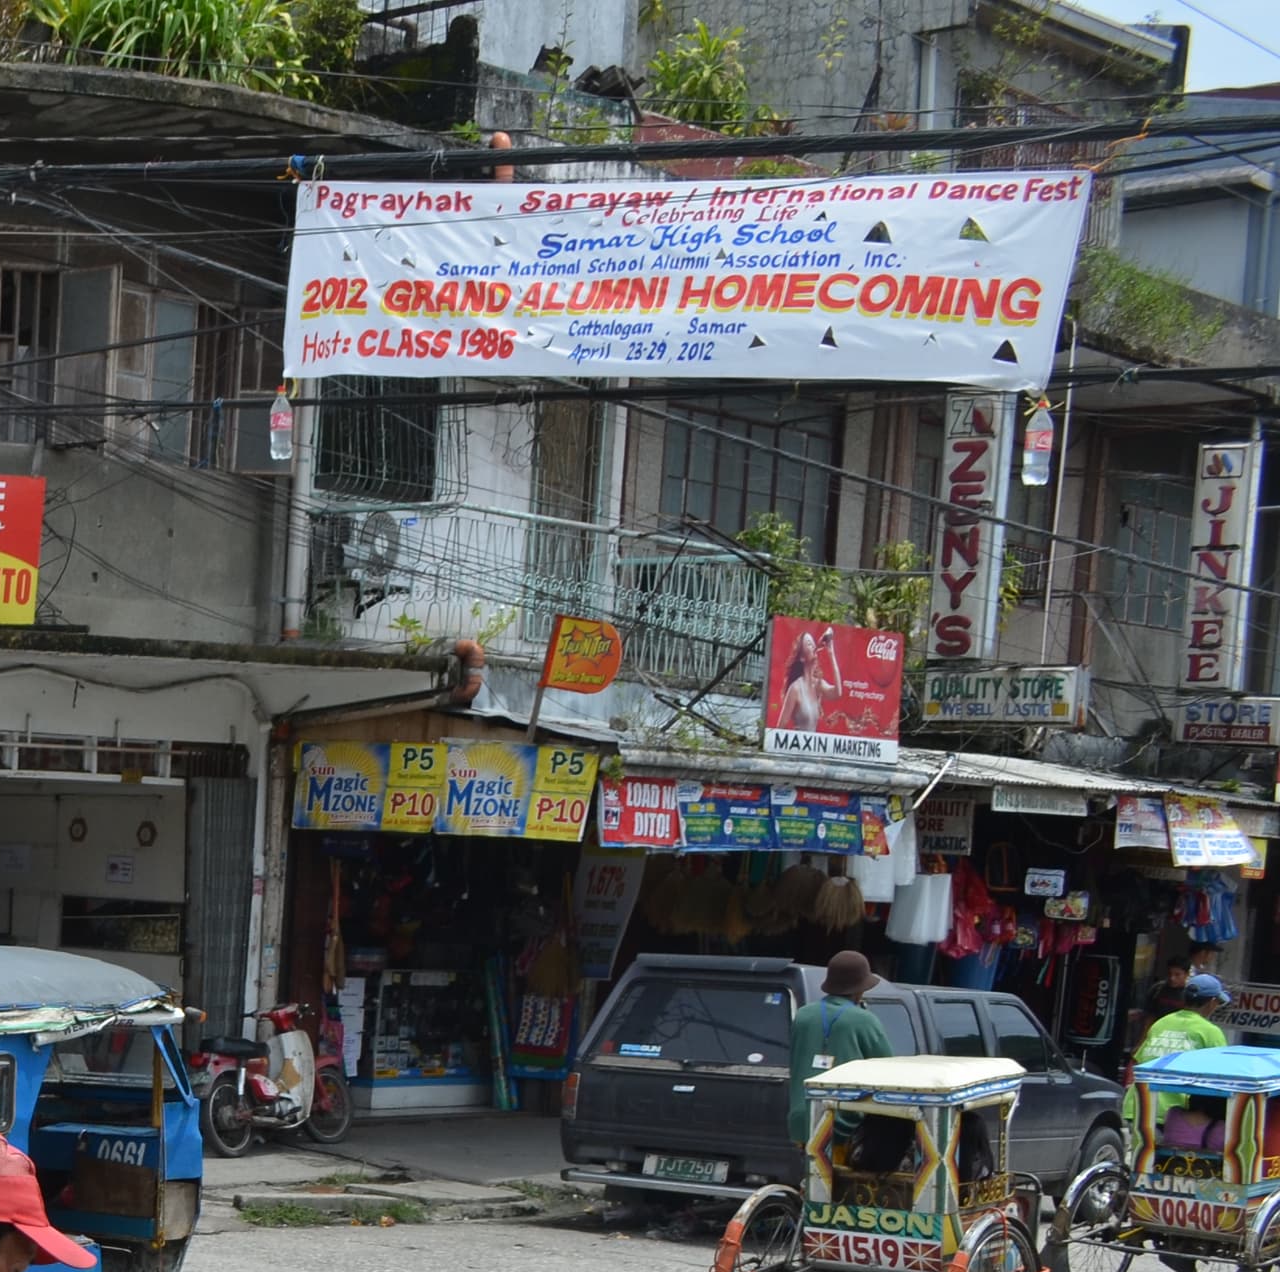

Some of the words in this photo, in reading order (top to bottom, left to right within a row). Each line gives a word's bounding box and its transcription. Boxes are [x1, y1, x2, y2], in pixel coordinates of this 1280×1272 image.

[708, 182, 918, 208] International
[928, 179, 1017, 201] Dance
[1022, 174, 1083, 203] Fest
[621, 204, 745, 228] Celebrating
[537, 232, 648, 260] Samar
[648, 223, 724, 251] High
[731, 220, 838, 246] School
[436, 261, 501, 277] Samar
[507, 258, 581, 278] National
[587, 257, 644, 274] School
[650, 253, 711, 272] Alumni
[721, 250, 842, 271] Association
[300, 277, 368, 320] 2012
[380, 278, 513, 321] GRAND
[514, 275, 671, 318] ALUMNI
[674, 271, 1043, 327] HOMECOMING
[686, 316, 748, 336] Samar
[356, 328, 453, 360] CLASS
[456, 327, 518, 361] 1986
[566, 341, 612, 361] April
[676, 340, 716, 361] 2012
[1185, 485, 1237, 683] JINKEE
[930, 675, 1004, 701] QUALITY
[1008, 676, 1065, 700] STORE
[941, 702, 963, 718] WE
[965, 702, 992, 718] SELL
[1185, 701, 1273, 726] STORE
[774, 731, 828, 755] MAXIN
[832, 736, 882, 759] MARKETING
[310, 765, 336, 778] sun
[449, 766, 478, 779] sun
[305, 772, 370, 812] Magic
[329, 794, 377, 813] ZONE
[445, 777, 514, 817] Magic
[626, 781, 660, 809] LOAD
[471, 796, 522, 818] ZONE
[633, 811, 671, 839] DITO!
[1094, 979, 1110, 1017] zero
[1135, 1172, 1196, 1196] AJM
[808, 1203, 935, 1238] JASON
[1161, 1198, 1213, 1232] 0040
[840, 1234, 900, 1268] 1519
